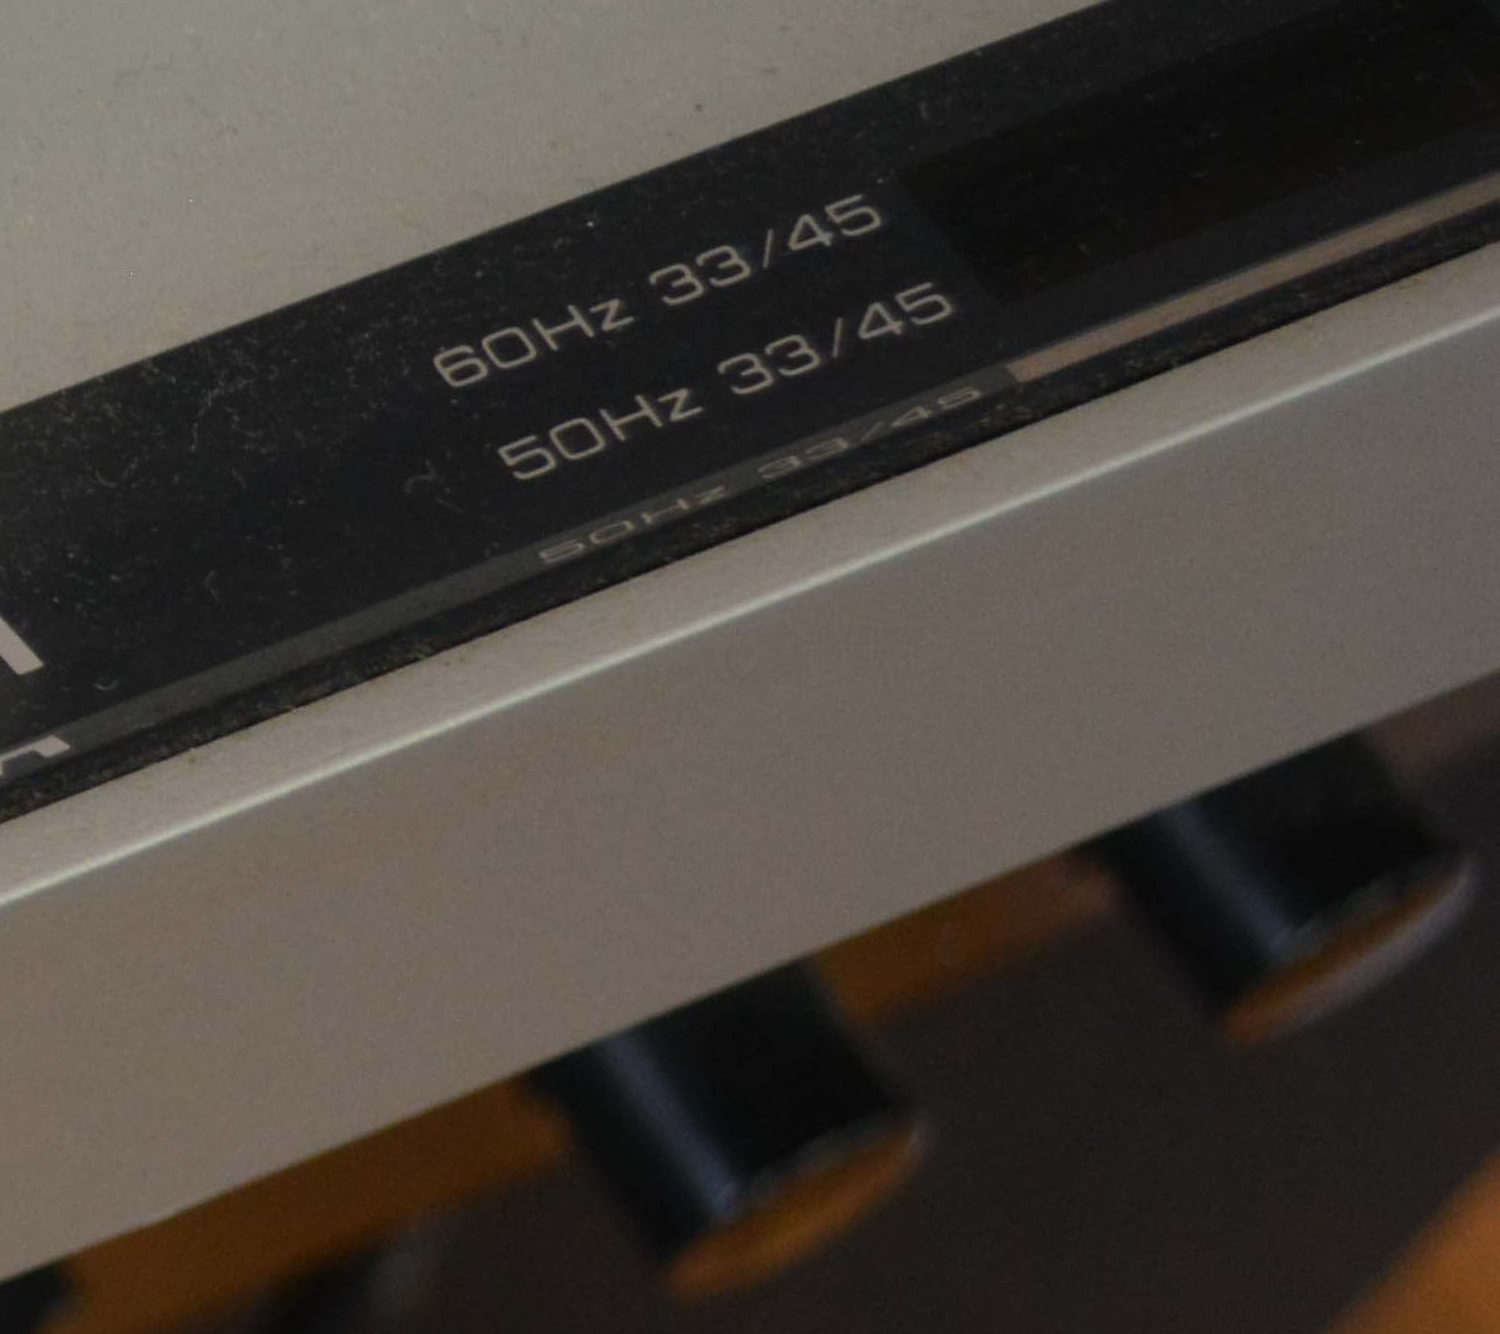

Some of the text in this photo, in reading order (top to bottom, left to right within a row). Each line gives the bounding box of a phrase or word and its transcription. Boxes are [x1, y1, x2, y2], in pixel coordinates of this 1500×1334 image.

[432, 194, 883, 388] 60Hz 33/45
[497, 281, 954, 481] 50Hz 33/45
